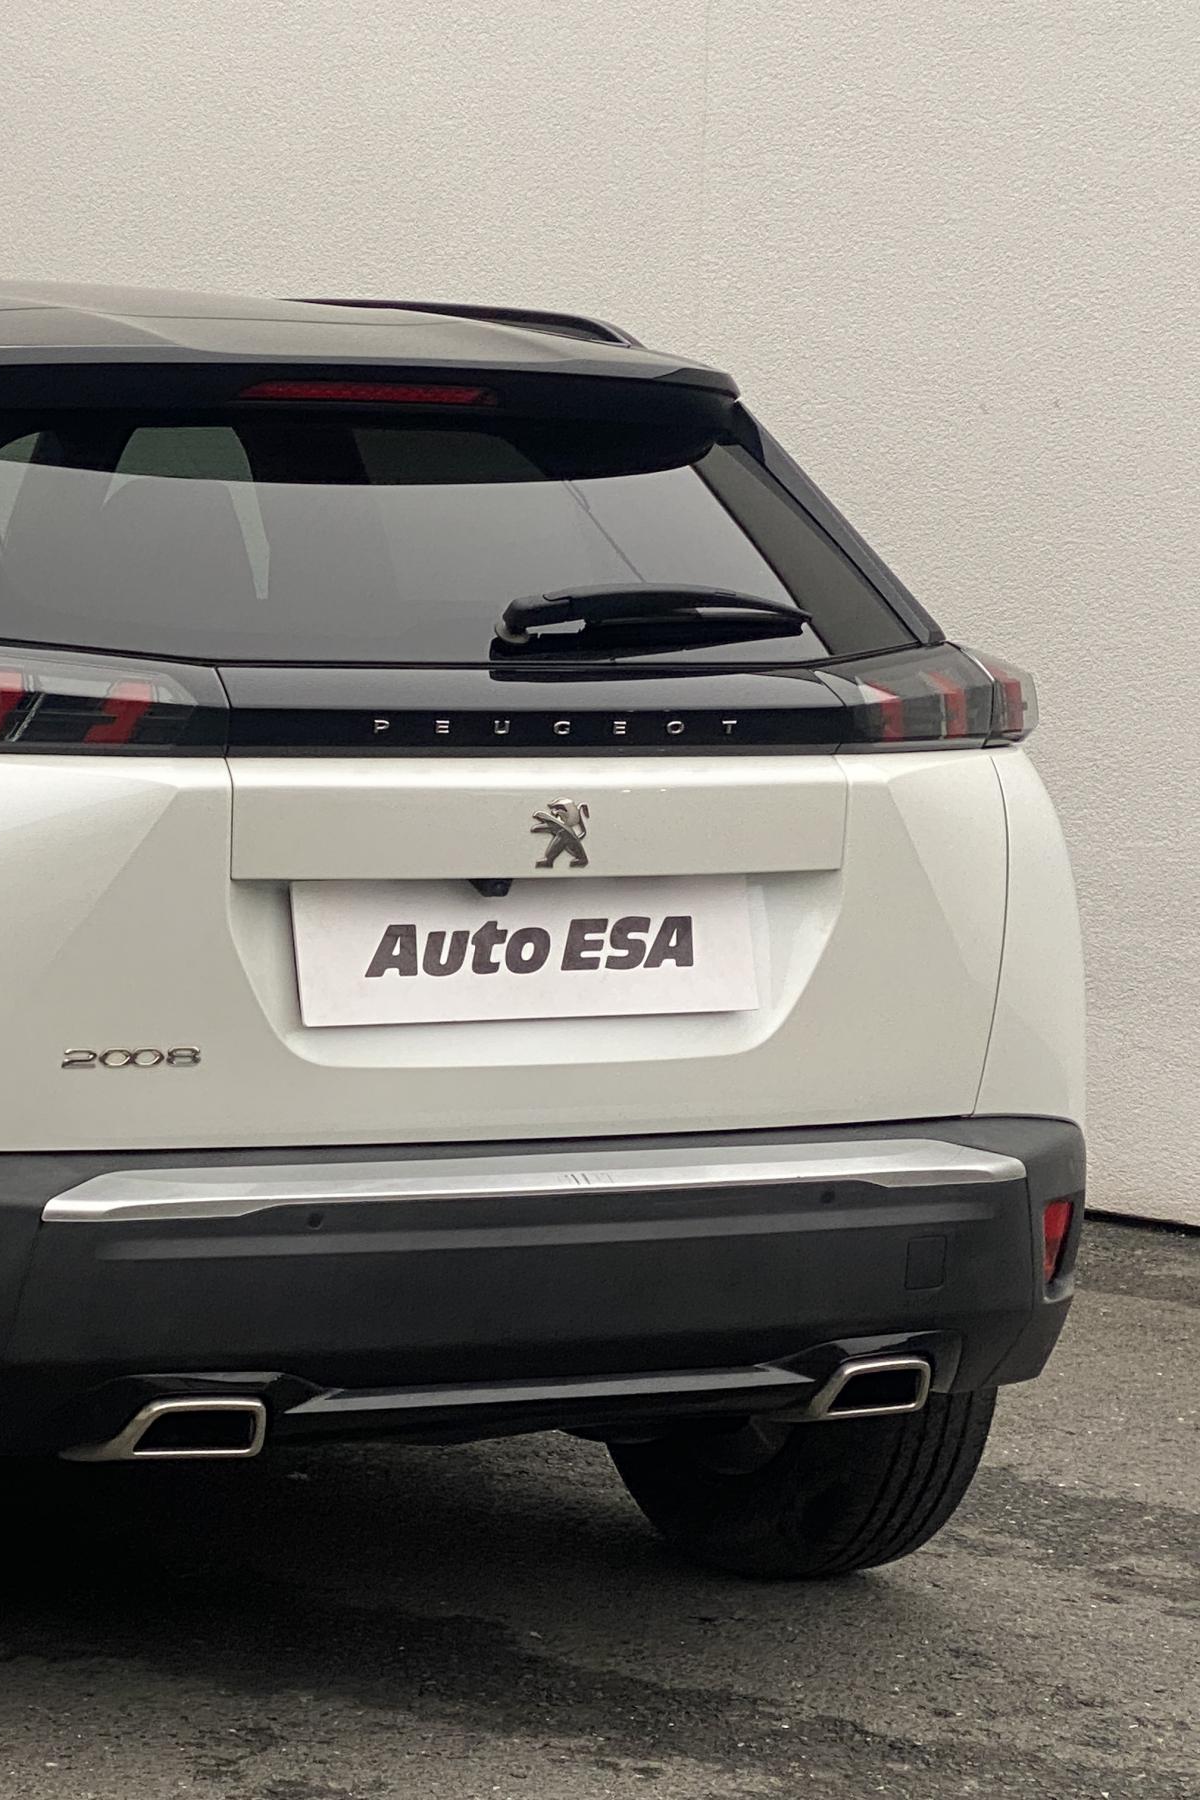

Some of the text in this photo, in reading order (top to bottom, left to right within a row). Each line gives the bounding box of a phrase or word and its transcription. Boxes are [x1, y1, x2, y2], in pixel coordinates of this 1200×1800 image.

[373, 718, 738, 736] PEUGEOT
[364, 915, 694, 977] Auto ESA
[61, 1046, 201, 1068] 2008
